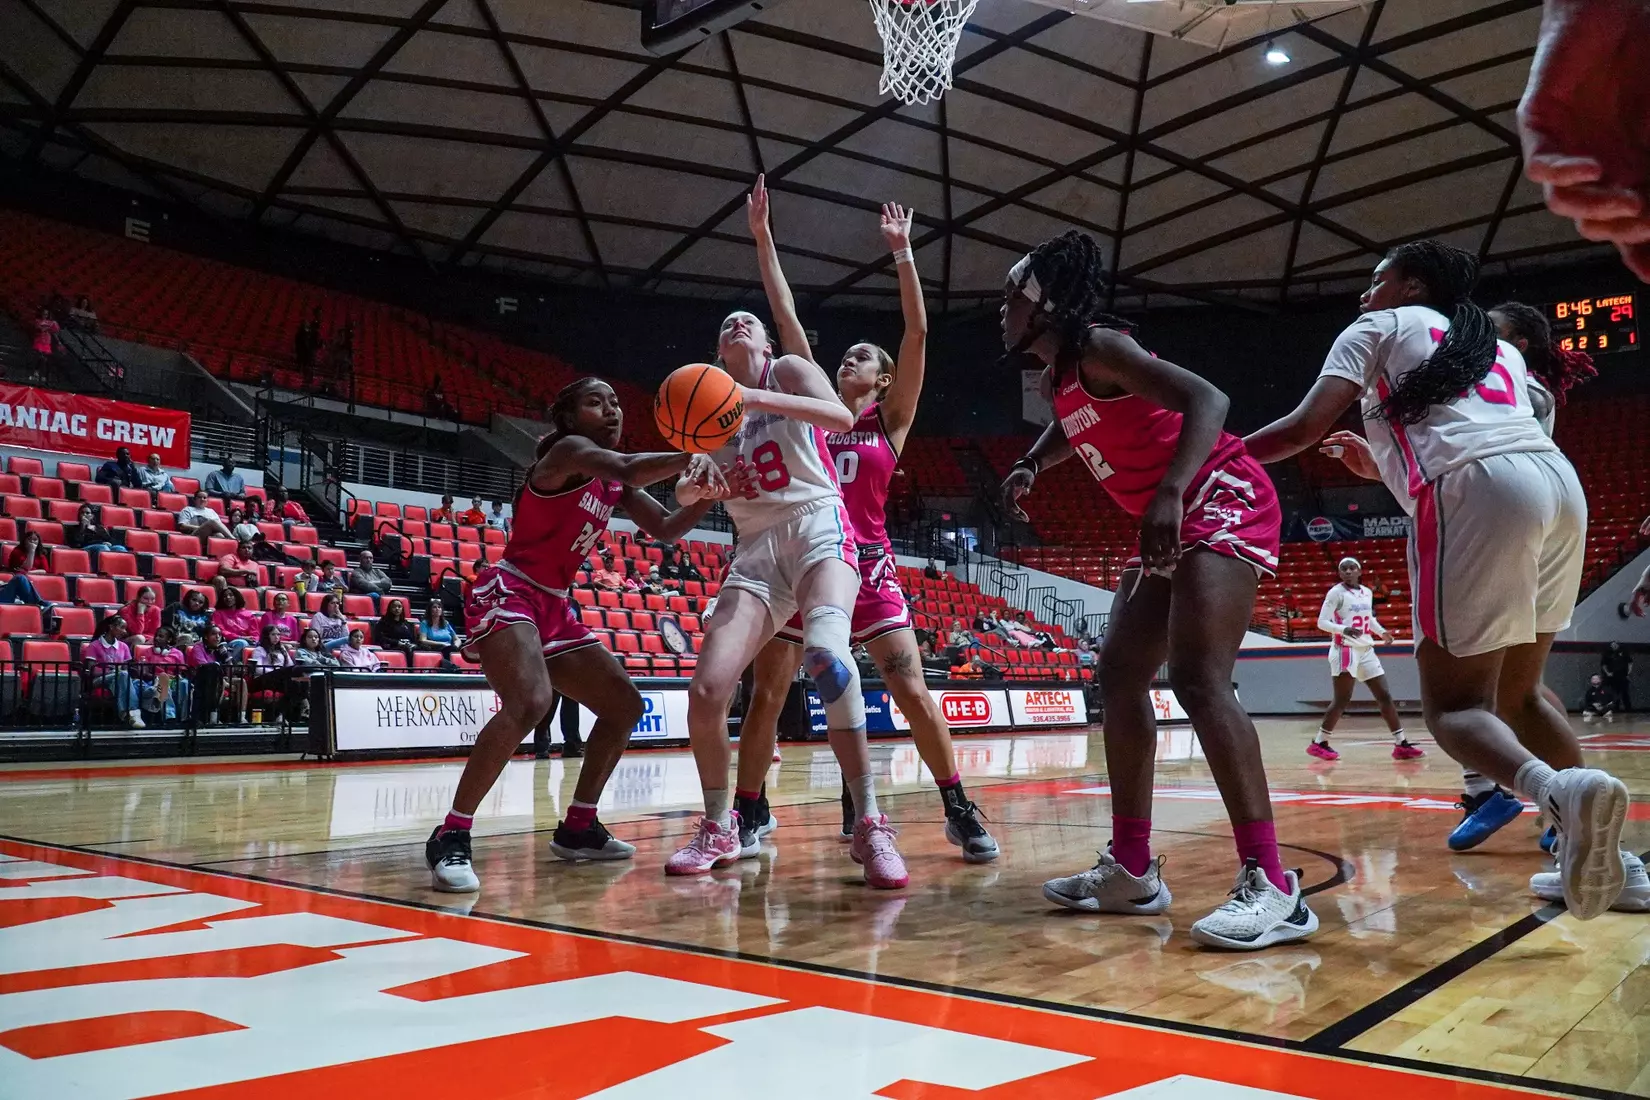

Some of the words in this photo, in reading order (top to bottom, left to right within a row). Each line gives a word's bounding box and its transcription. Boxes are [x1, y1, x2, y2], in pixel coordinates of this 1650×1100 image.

[125, 217, 150, 243] E
[499, 297, 518, 314] F
[1556, 299, 1593, 319] 8:46
[1596, 295, 1632, 308] LATECH
[1610, 304, 1633, 322] 29
[1576, 317, 1585, 330] 3
[1578, 336, 1588, 349] 2
[1598, 335, 1608, 348] 3
[1629, 332, 1635, 344] 1
[96, 418, 176, 448] CREW
[827, 431, 879, 448] HOUSTON
[835, 450, 859, 484] 0
[570, 521, 603, 556] 24
[1364, 525, 1404, 537] BEARKAT
[376, 695, 477, 713] MEMORIAL
[808, 696, 821, 705] The
[1025, 691, 1072, 706] ARTECH
[377, 710, 477, 727] HERMANN
